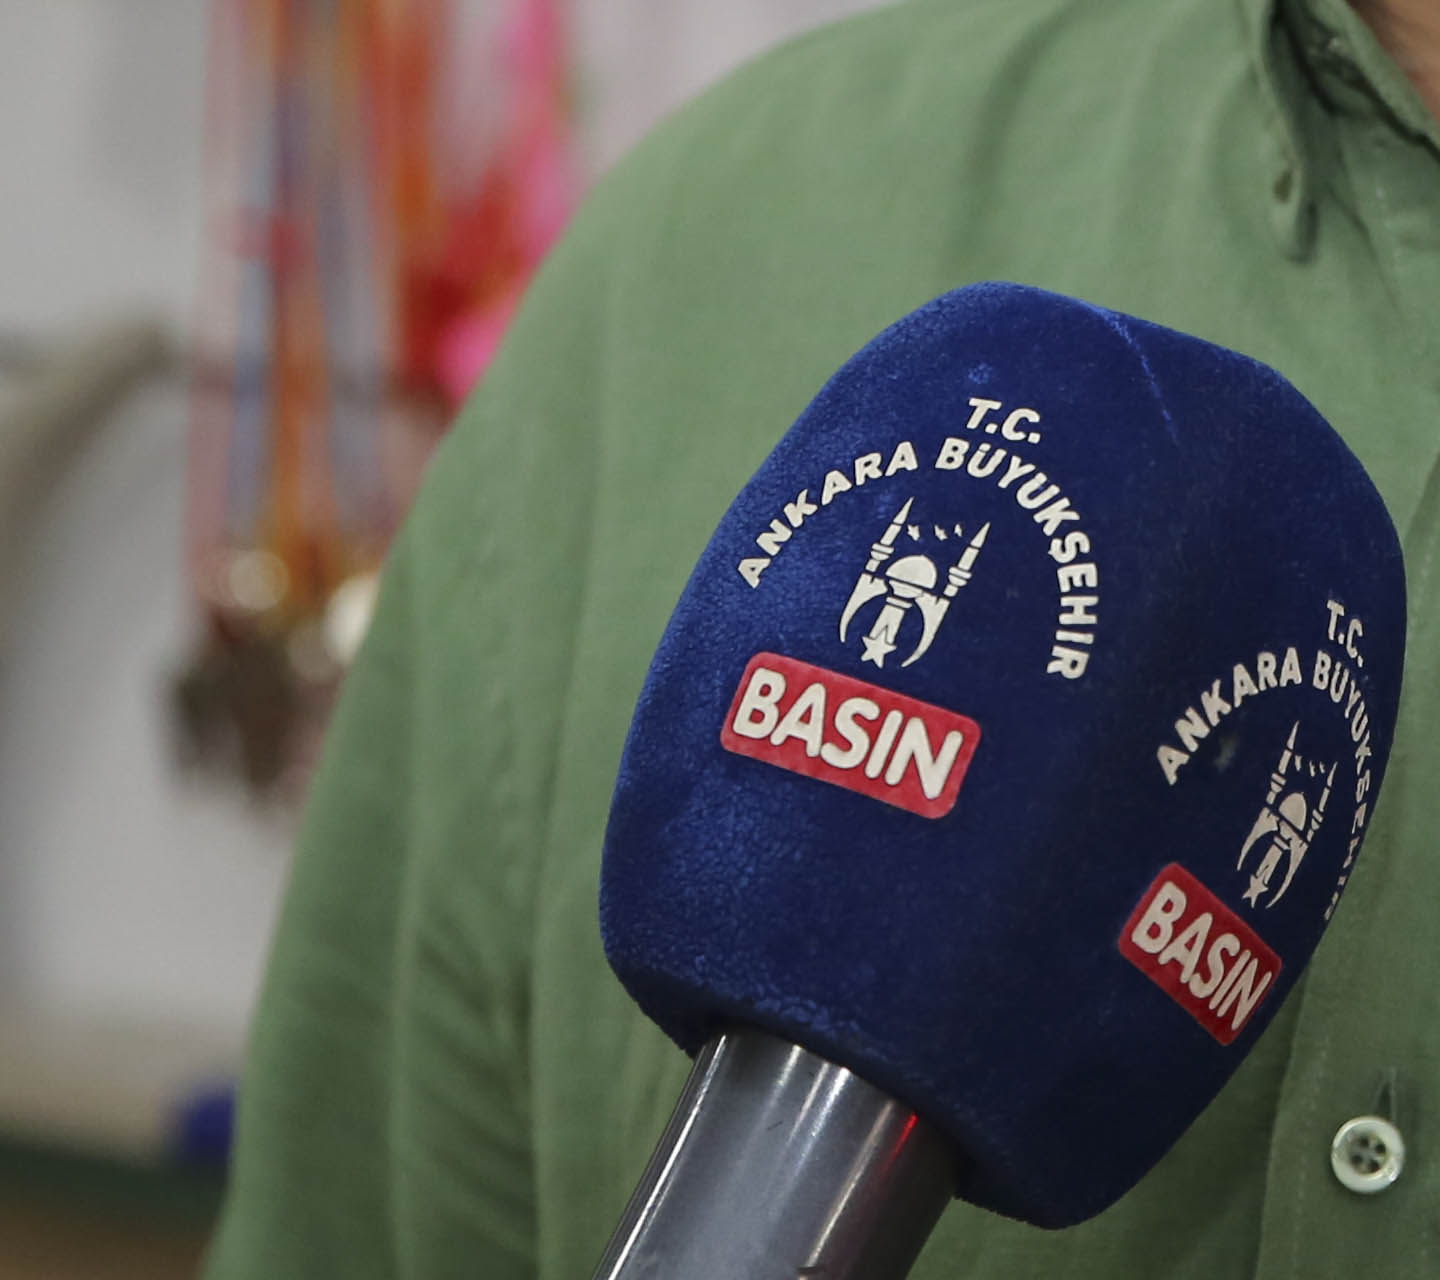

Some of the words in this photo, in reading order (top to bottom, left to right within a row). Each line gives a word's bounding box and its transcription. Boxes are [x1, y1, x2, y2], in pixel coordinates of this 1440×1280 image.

[966, 397, 1041, 444] T.C.
[737, 441, 918, 589] ANKARA
[1326, 599, 1364, 668] T.C.
[732, 667, 964, 799] BASIN
[1157, 647, 1302, 785] ANKARA
[1131, 881, 1272, 1031] BASIN
